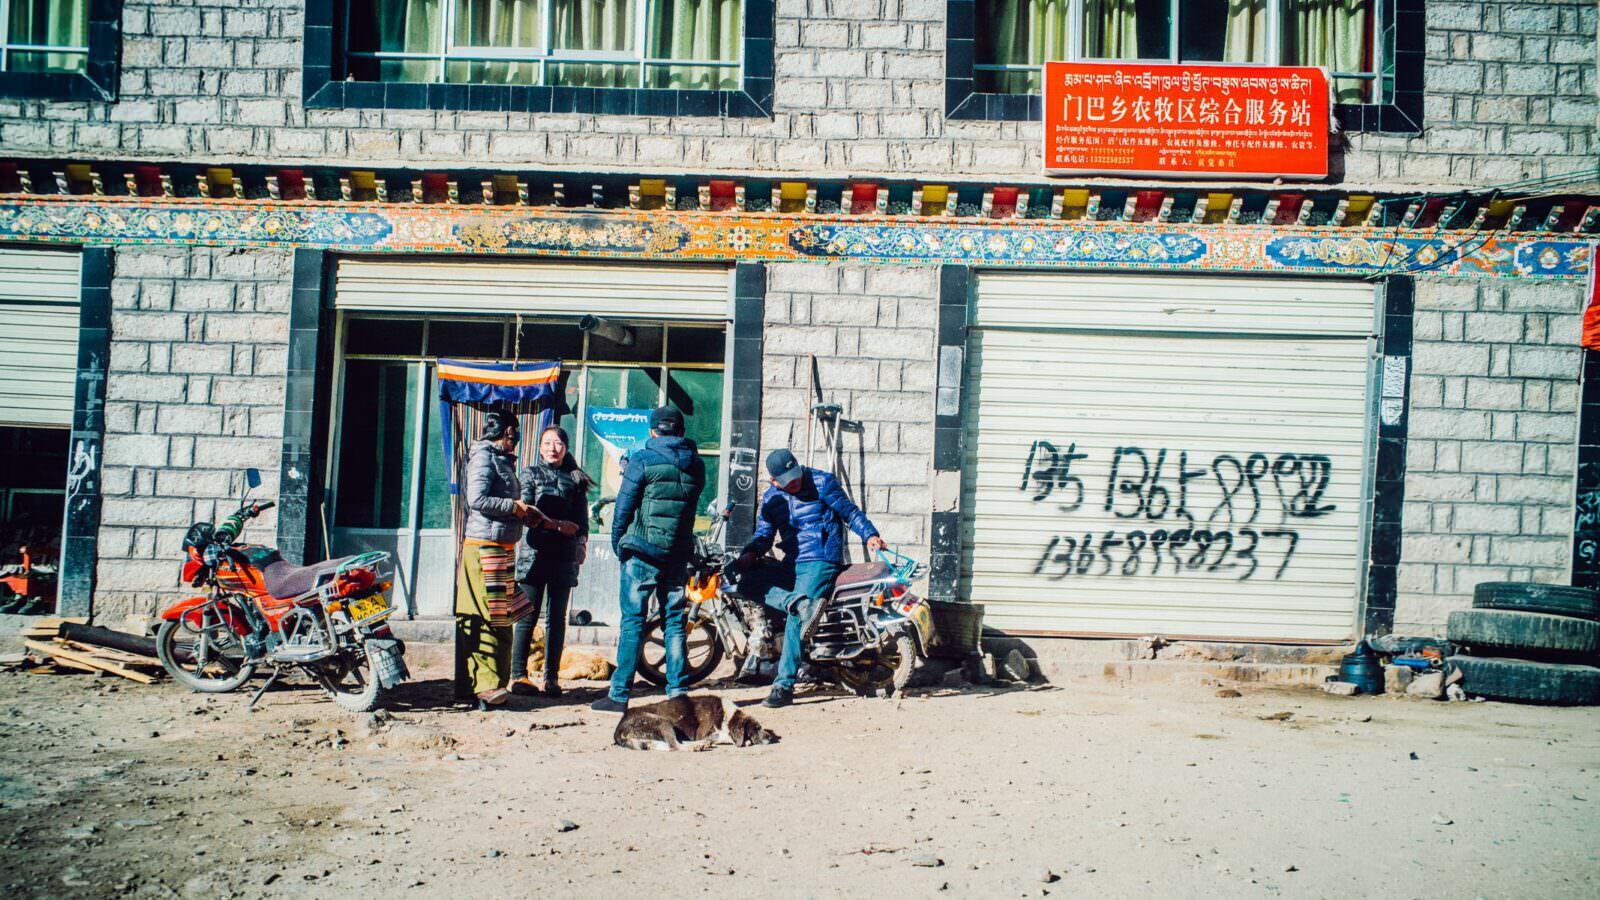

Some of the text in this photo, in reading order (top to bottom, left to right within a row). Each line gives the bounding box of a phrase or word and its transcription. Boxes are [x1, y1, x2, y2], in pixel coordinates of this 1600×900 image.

[1063, 93, 1311, 126] 门巴乡农牧区综合服务站
